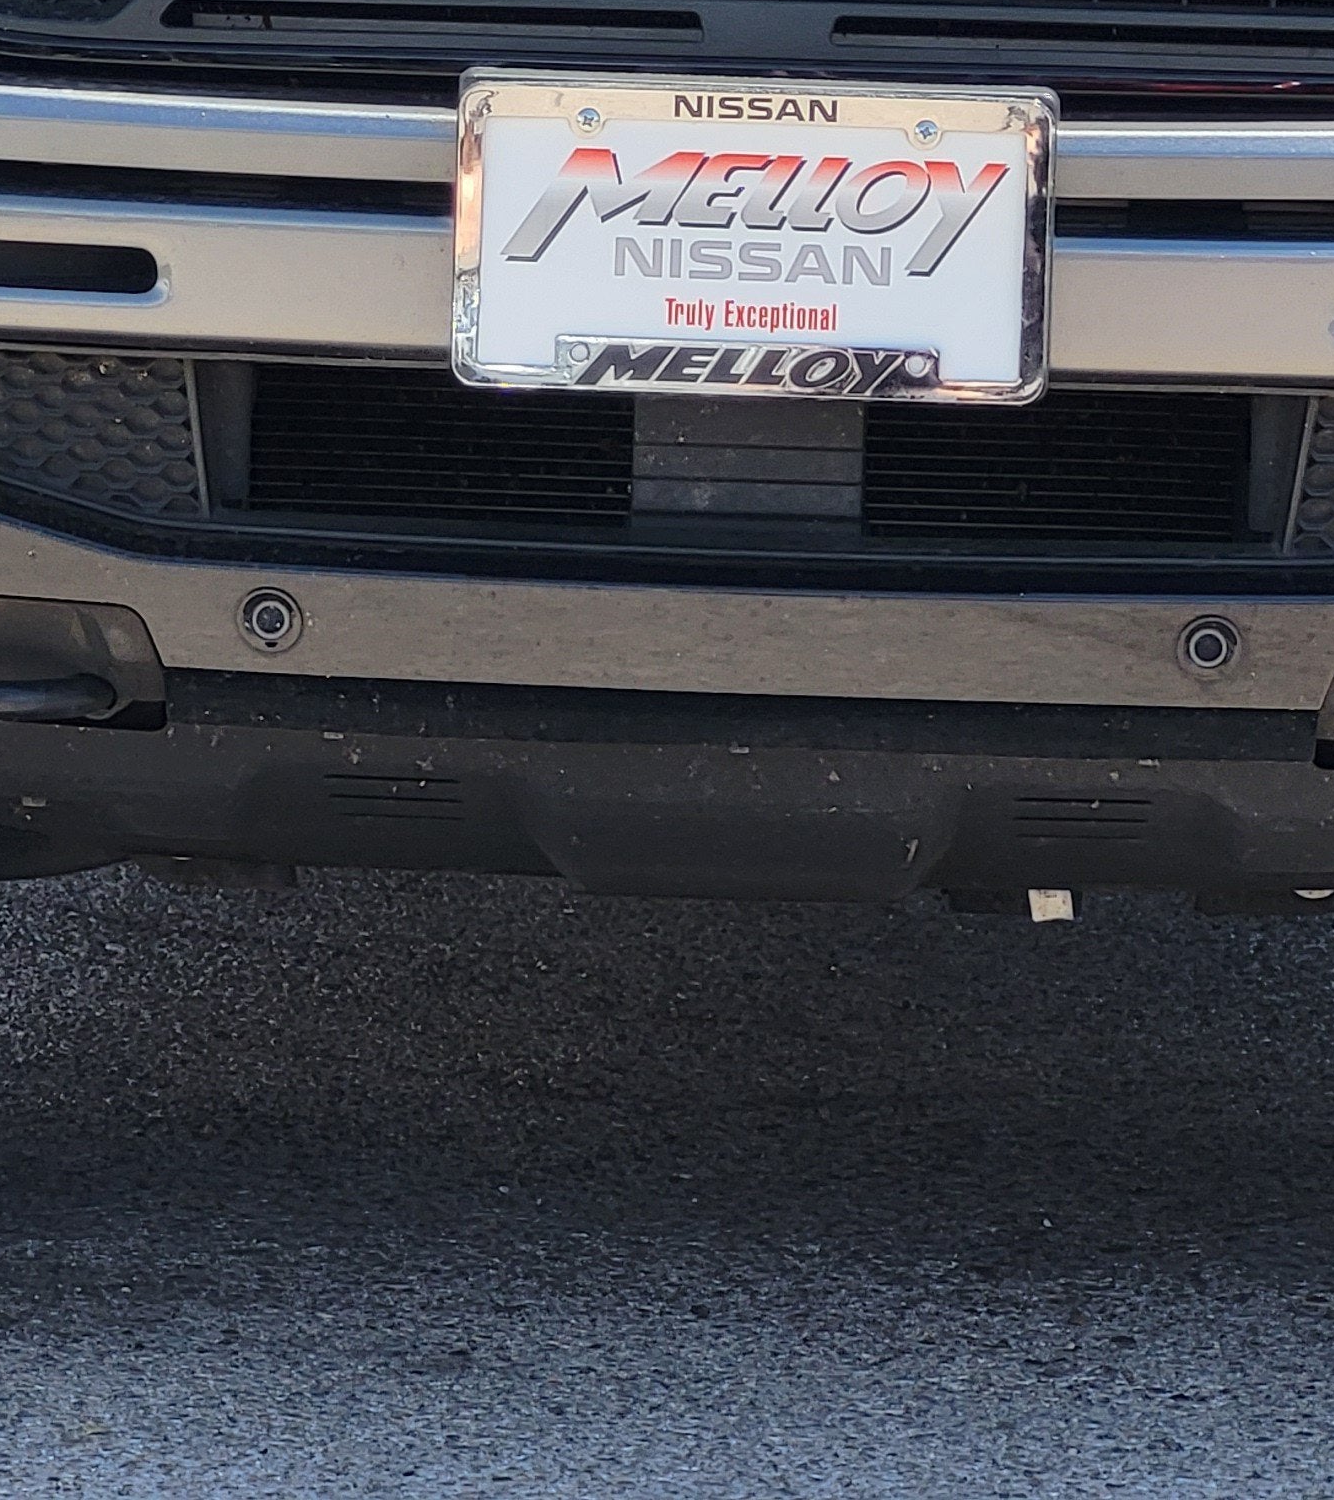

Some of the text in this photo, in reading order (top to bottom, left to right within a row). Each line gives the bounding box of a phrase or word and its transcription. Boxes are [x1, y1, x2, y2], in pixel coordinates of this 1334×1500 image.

[672, 93, 838, 123] NISSAN
[501, 146, 1010, 277] MELLOY
[613, 235, 891, 287] NISSAN
[664, 297, 838, 334] Truly Exceptional
[570, 344, 905, 394] MELLOY
